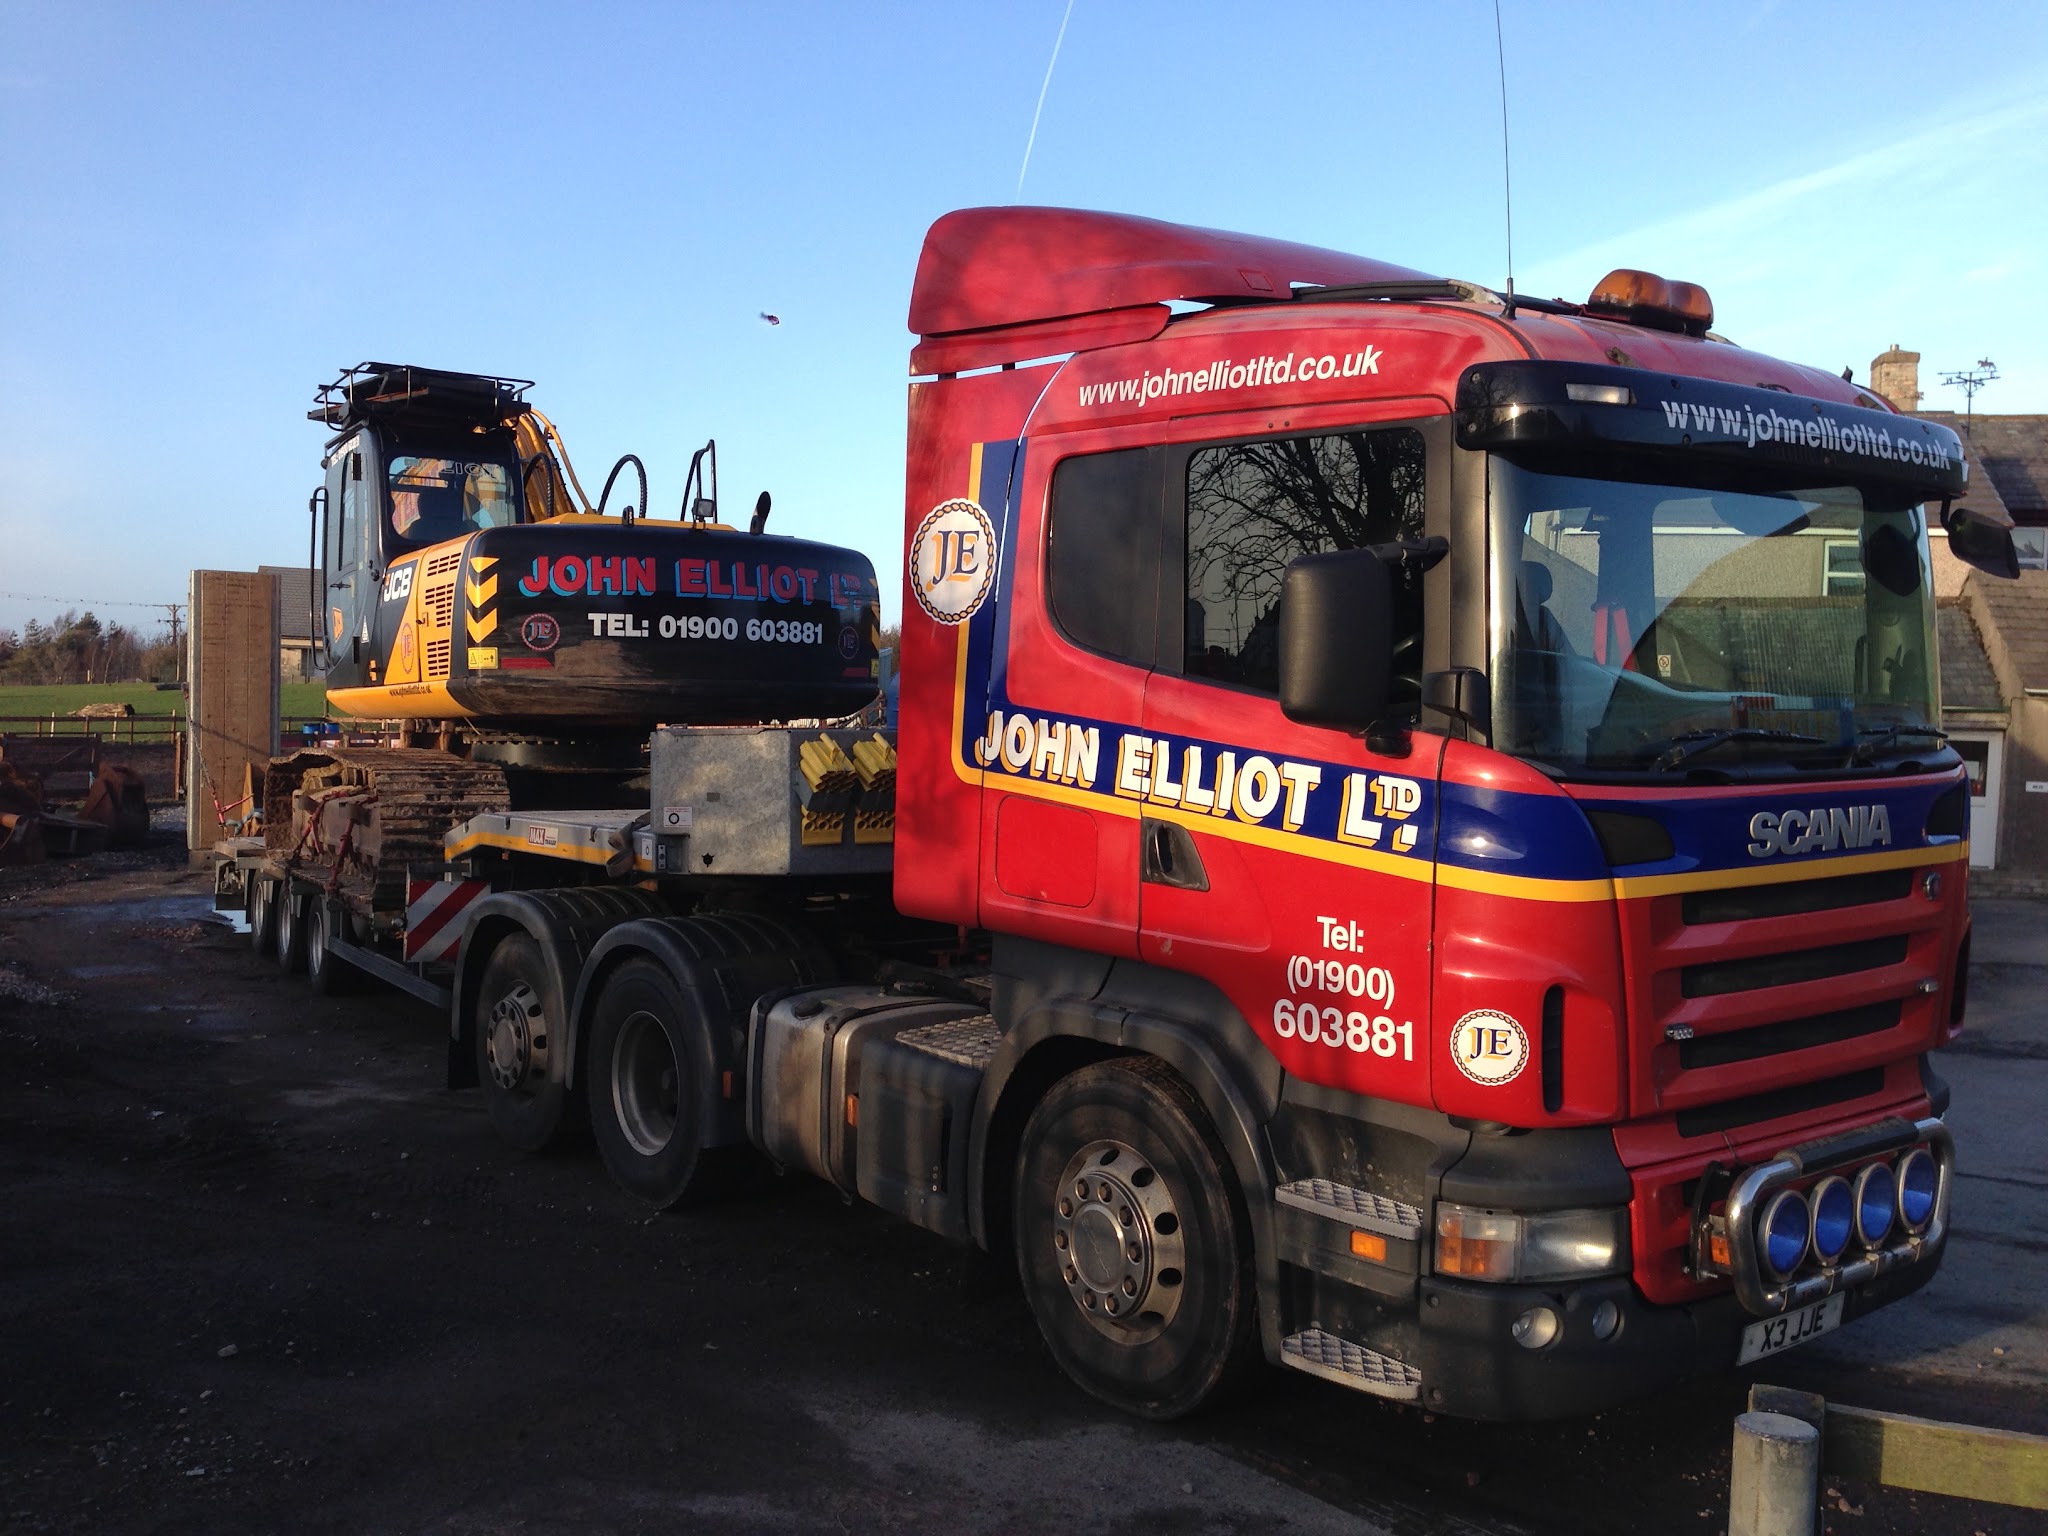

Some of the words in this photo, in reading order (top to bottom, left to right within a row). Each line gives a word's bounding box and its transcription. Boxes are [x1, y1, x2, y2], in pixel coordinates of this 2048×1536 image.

[1079, 345, 1383, 407] www.johnelliotltd.co.uk
[1661, 400, 1950, 470] www.johnelliotltd.co.uk
[384, 567, 413, 602] JCB
[519, 556, 656, 597] JOHN
[675, 559, 819, 605] ELLIOT
[926, 530, 979, 592] JE
[528, 621, 552, 642] JE
[588, 613, 649, 637] TEL:
[659, 615, 738, 641] 01900
[746, 619, 823, 644] 603881
[975, 710, 1100, 788] JOHN
[1115, 734, 1321, 832] ELLIOT
[529, 827, 545, 845] MAX
[1748, 805, 1891, 858] SCANIA
[1317, 916, 1364, 953] Tel:
[1287, 955, 1395, 1010] (01900)
[1273, 999, 1413, 1061] 603881
[1465, 1027, 1512, 1063] JE
[1761, 1318, 1787, 1352] X3
[1791, 1303, 1826, 1342] JJE
